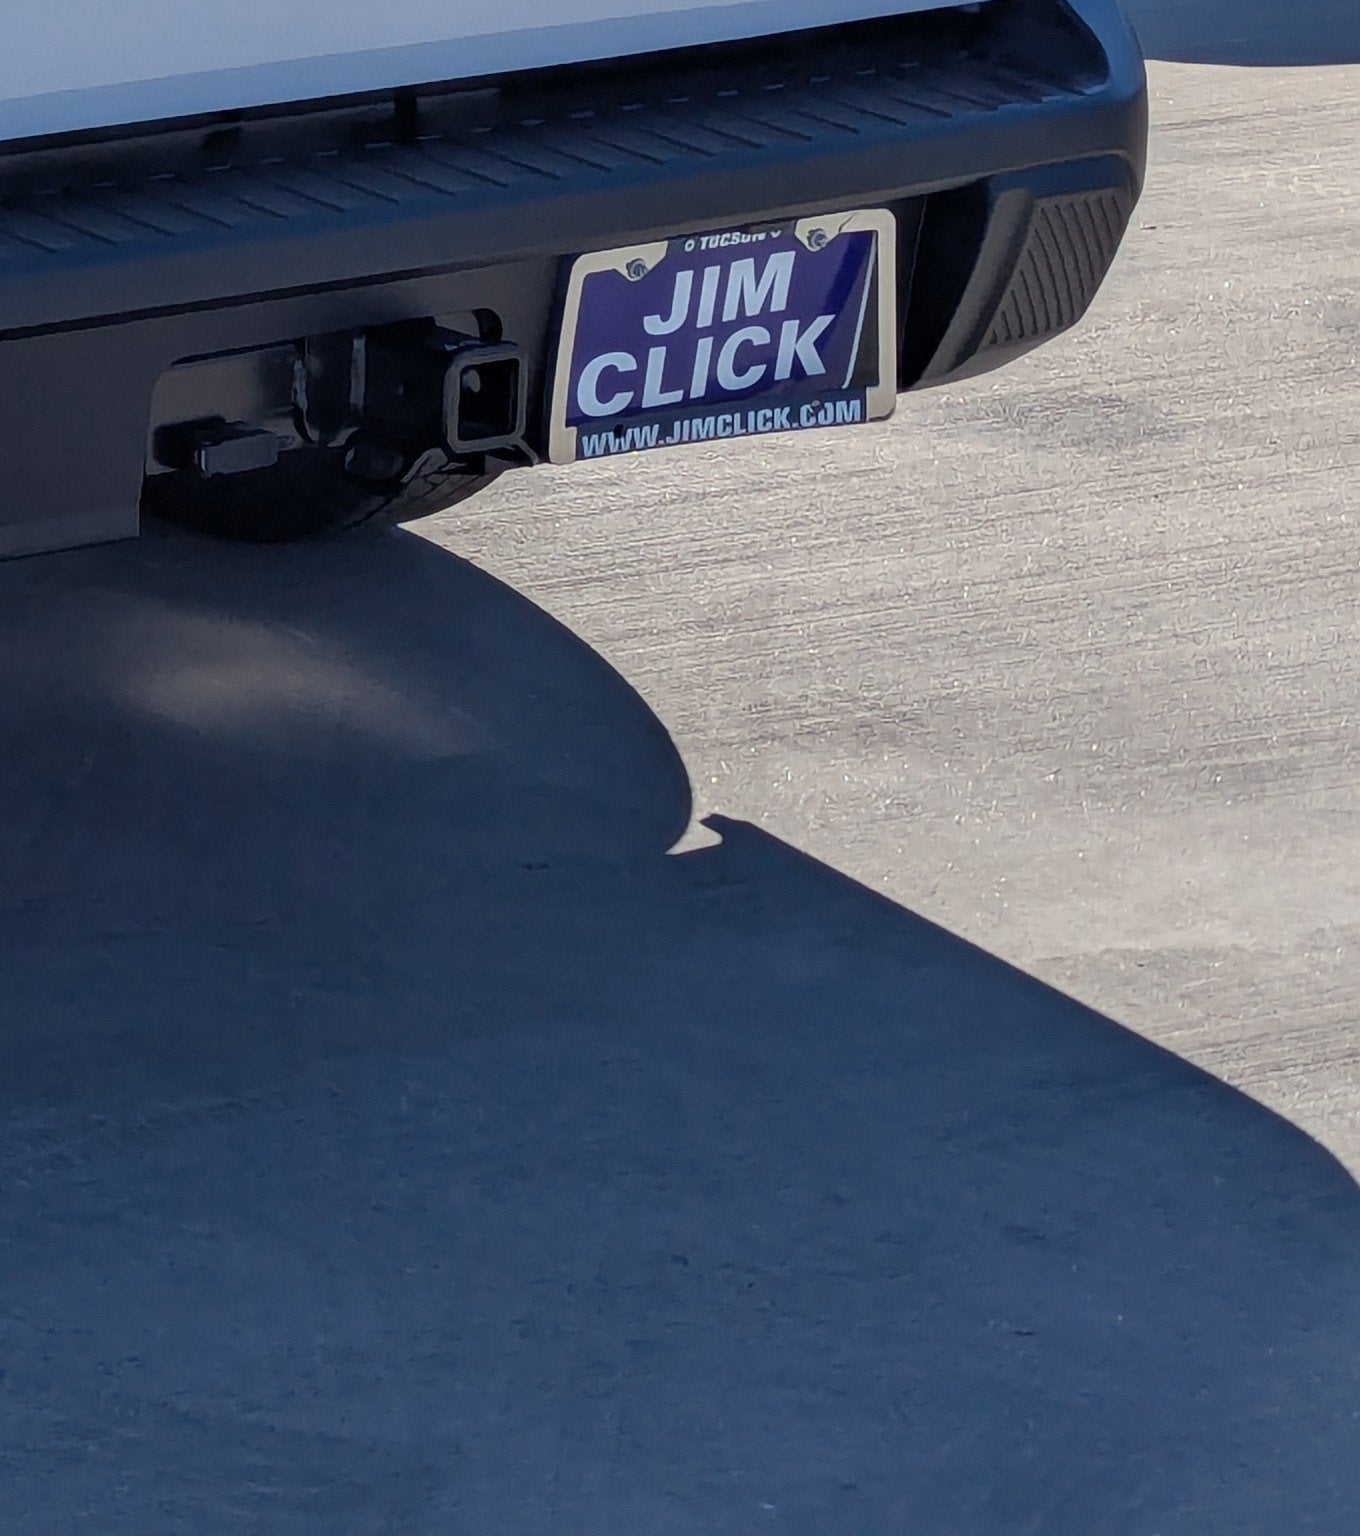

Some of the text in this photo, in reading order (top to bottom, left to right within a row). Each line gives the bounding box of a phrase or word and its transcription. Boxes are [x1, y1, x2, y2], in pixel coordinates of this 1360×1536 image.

[643, 251, 796, 336] JIM
[577, 314, 837, 418] CLICK
[582, 399, 861, 458] WWW.JIMCLICK.COM
